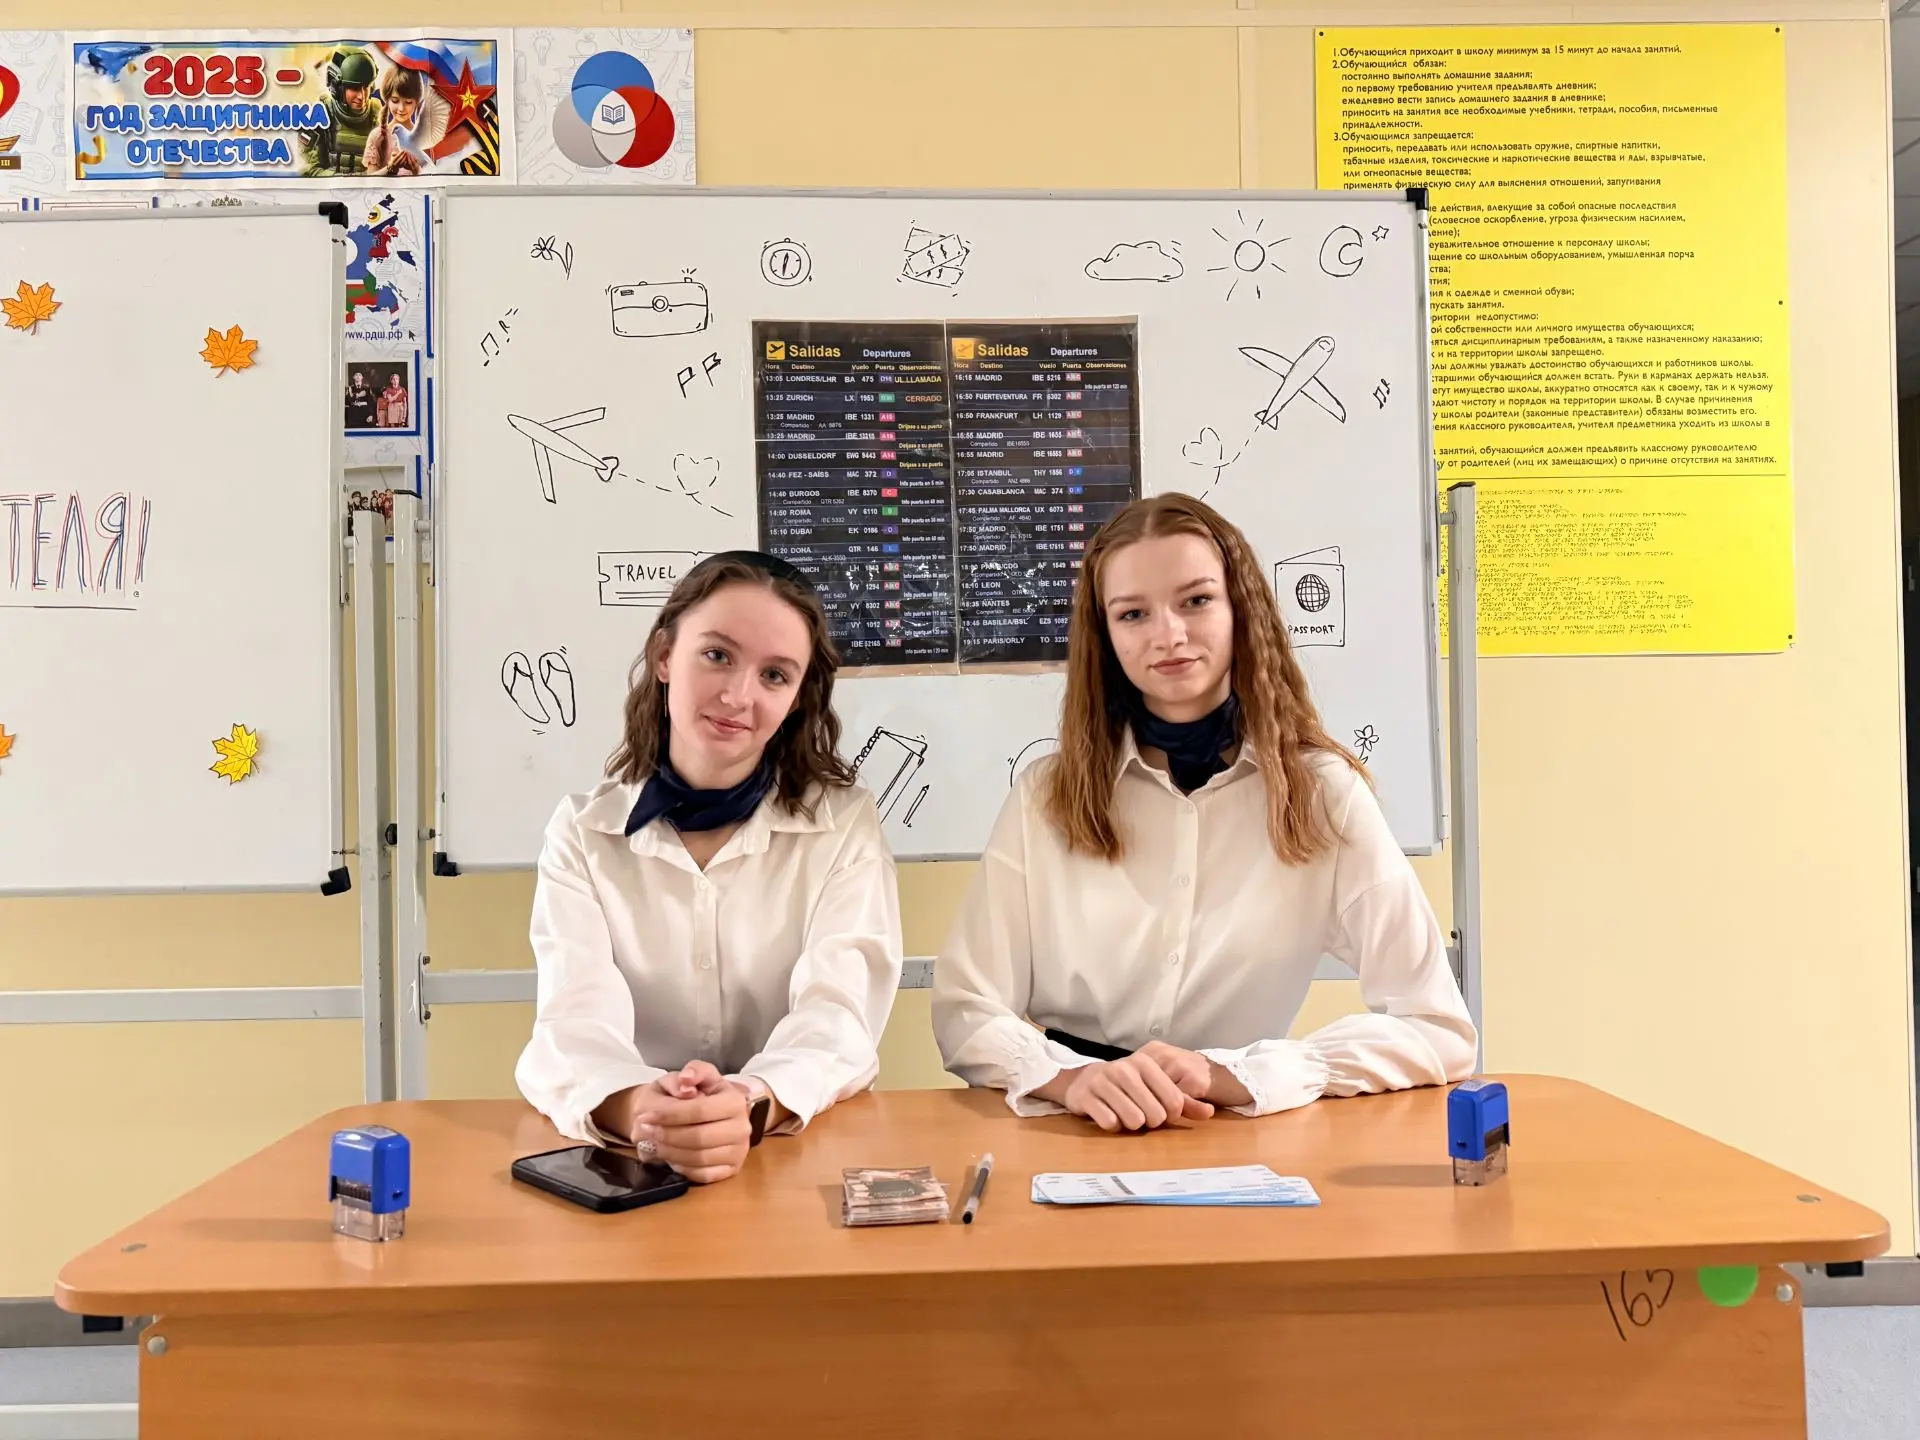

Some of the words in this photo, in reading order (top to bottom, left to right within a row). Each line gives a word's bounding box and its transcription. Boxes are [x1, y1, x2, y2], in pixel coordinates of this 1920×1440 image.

[1409, 48, 1454, 59] приходит
[1456, 48, 1462, 56] в
[1464, 47, 1495, 57] школу
[1496, 47, 1539, 57] минимум
[1541, 47, 1551, 55] за
[1554, 44, 1565, 55] 15
[1566, 47, 1595, 57] минут
[1596, 46, 1609, 55] до
[1611, 46, 1642, 54] начала
[1644, 44, 1682, 54] занятий.
[1412, 58, 1447, 69] обязан:
[143, 54, 266, 97] 2025
[276, 68, 302, 83] -
[1341, 73, 1391, 82] постоянно
[1392, 72, 1442, 81] выполнять
[1443, 71, 1492, 81] домашние
[1494, 71, 1533, 80] задания;
[1341, 85, 1354, 94] по
[1355, 84, 1396, 95] первому
[1397, 82, 1454, 95] требованию
[1456, 84, 1493, 95] учителя
[1555, 82, 1597, 91] дневник;
[1341, 97, 1395, 107] ежедневно
[1396, 96, 1423, 105] вести
[1425, 96, 1456, 105] запись
[1458, 94, 1511, 104] домашнего
[1512, 95, 1549, 103] задания
[1551, 94, 1557, 103] в
[1559, 94, 1606, 104] дневнике;
[87, 103, 143, 132] ГОД
[150, 103, 329, 133] ЗАЩИТНИКА
[1341, 108, 1391, 120] приносить
[1392, 108, 1404, 117] на
[1405, 108, 1442, 116] занятия
[1443, 108, 1460, 116] все
[1462, 104, 1527, 116] необходимые
[1528, 104, 1576, 117] учебники,
[1577, 105, 1617, 116] тетради,
[1618, 103, 1660, 115] пособия,
[1662, 104, 1718, 113] письменные
[1342, 120, 1424, 132] принадлежности.
[1412, 131, 1474, 143] запрещается:
[127, 138, 291, 165] ОТЕЧЕСТВА
[1342, 145, 1394, 157] приносить,
[1395, 144, 1448, 155] передавать
[1450, 144, 1468, 153] или
[1470, 143, 1533, 151] использовать
[1534, 143, 1573, 153] оружие,
[1575, 141, 1619, 152] спиртные
[1621, 141, 1661, 150] напитки,
[1342, 153, 1386, 166] табачные
[1388, 156, 1429, 166] изделия,
[1431, 156, 1490, 165] токсические
[1492, 155, 1499, 163] и
[1501, 154, 1571, 165] наркотические
[1573, 153, 1617, 163] вещества
[1619, 154, 1626, 162] и
[1627, 154, 1649, 163] яды,
[1650, 154, 1706, 165] взрывчатые,
[1343, 170, 1361, 179] или
[1363, 168, 1423, 177] огнеопасные
[1425, 168, 1472, 177] вещества;
[1343, 181, 1393, 192] применять
[1454, 180, 1477, 191] силу
[1478, 179, 1496, 189] для
[1497, 179, 1548, 188] выяснения
[1549, 176, 1605, 188] отношений,
[1606, 178, 1662, 188] запугивания
[1439, 202, 1485, 214] действия,
[1486, 203, 1533, 214] влекущие
[1535, 203, 1546, 212] за
[1547, 201, 1576, 212] собой
[1577, 202, 1617, 211] опасные
[1619, 202, 1677, 211] последствия
[1428, 214, 1481, 227] (словесное
[1483, 213, 1547, 226] оскорбление,
[1548, 215, 1579, 226] угроза
[1580, 212, 1637, 225] физическим
[1639, 215, 1686, 224] насилием,
[1444, 323, 1513, 334] собственности
[1515, 325, 1533, 333] или
[1535, 325, 1573, 333] личного
[1575, 323, 1626, 334] имущества
[1627, 322, 1695, 334] обучающихся;
[789, 344, 841, 358] Salidas
[863, 348, 911, 359] Departures
[977, 343, 1029, 357] Salidas
[1050, 347, 1098, 357] Departures
[786, 375, 837, 384] LONDRES/LHR
[844, 375, 856, 383] BA
[861, 375, 874, 383] 475
[786, 394, 814, 402] ZURICH
[786, 413, 815, 421] MADRID
[787, 452, 837, 460] DUSSELDORF
[1438, 445, 1478, 457] занятий,
[1479, 444, 1545, 457] обучающийся
[1546, 446, 1584, 455] должен
[1640, 445, 1689, 455] классному
[1691, 444, 1758, 454] руководителю
[1447, 460, 1459, 468] от
[1460, 456, 1511, 469] родителей
[1512, 456, 1535, 469] (лиц
[1536, 458, 1549, 466] их
[1551, 455, 1618, 468] замещающих)
[1620, 457, 1627, 465] о
[1628, 457, 1668, 468] причине
[1670, 456, 1719, 467] отсутствия
[1721, 456, 1733, 464] на
[1734, 456, 1777, 464] занятиях.
[978, 506, 998, 514] PALMA
[613, 563, 677, 582] TRAVEL
[1287, 624, 1336, 635] PASSPORT
